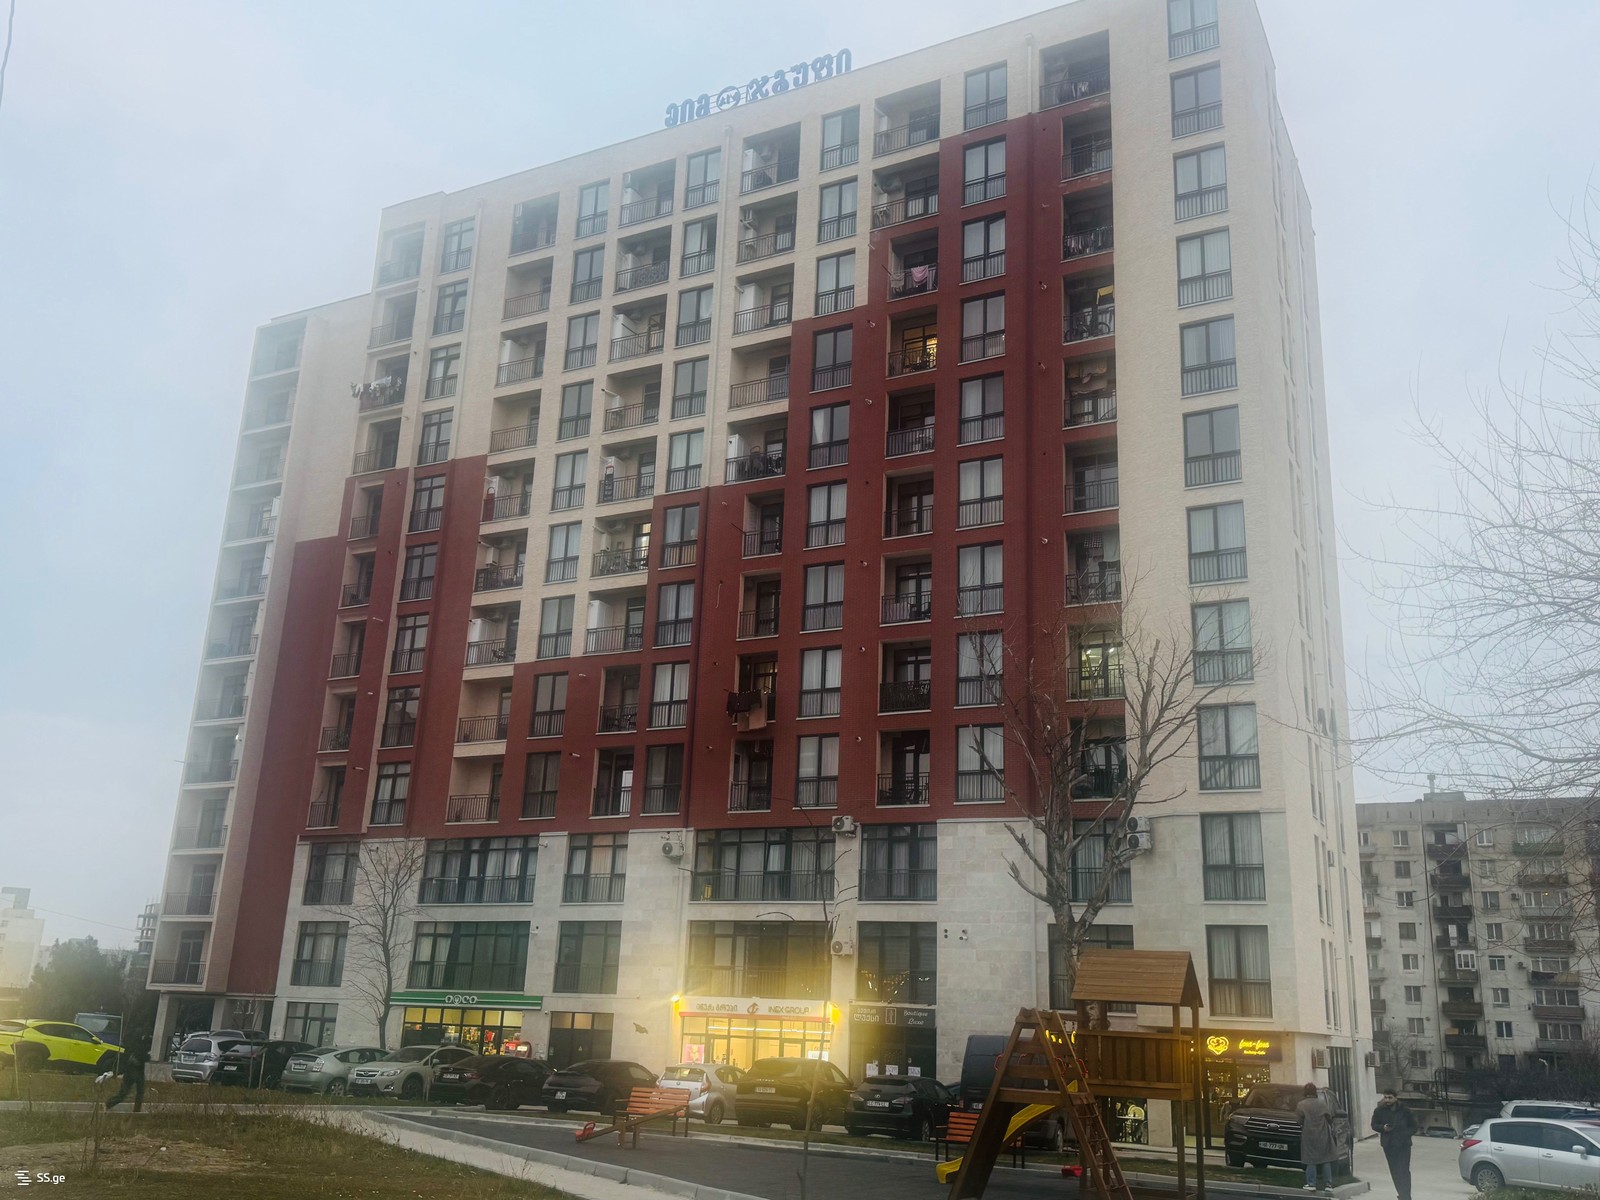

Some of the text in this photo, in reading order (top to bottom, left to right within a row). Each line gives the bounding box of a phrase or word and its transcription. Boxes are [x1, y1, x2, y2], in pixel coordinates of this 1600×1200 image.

[748, 47, 852, 102] ჯგუფი
[785, 1006, 809, 1015] GROUP
[904, 1009, 928, 1017] Boutique
